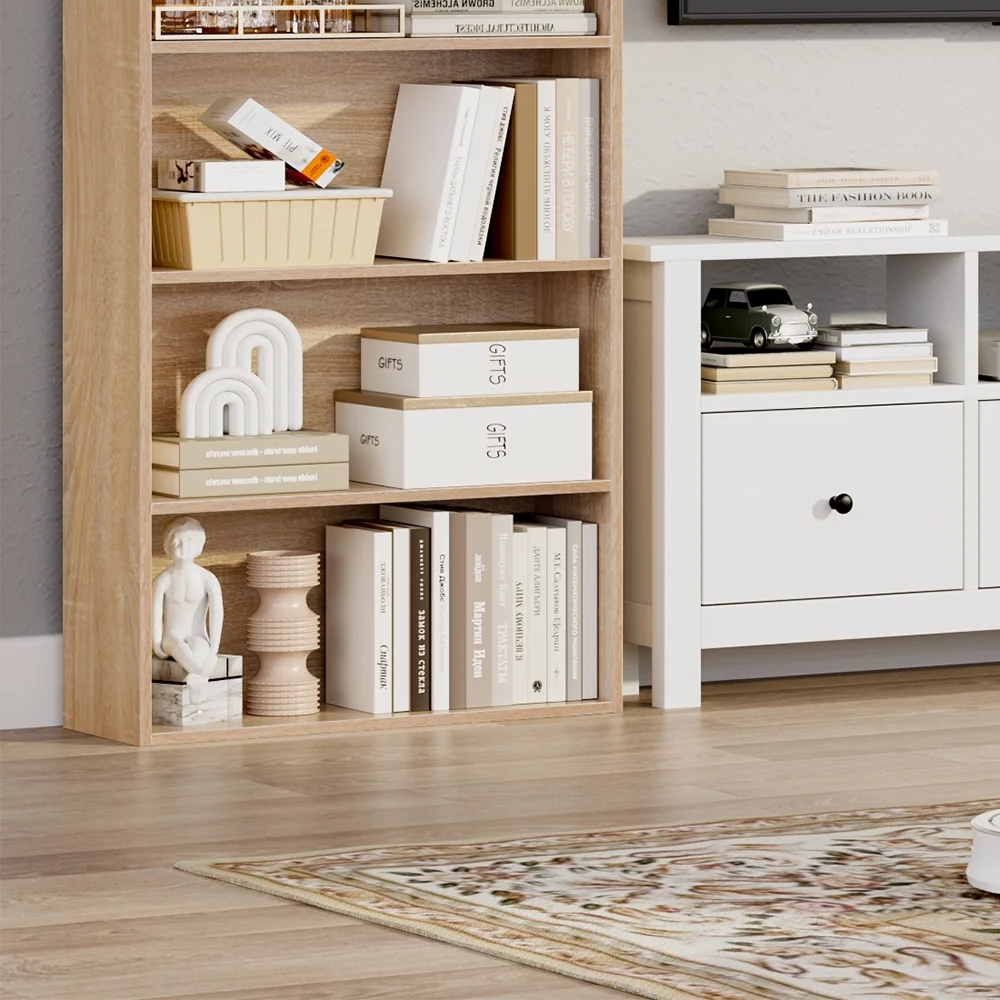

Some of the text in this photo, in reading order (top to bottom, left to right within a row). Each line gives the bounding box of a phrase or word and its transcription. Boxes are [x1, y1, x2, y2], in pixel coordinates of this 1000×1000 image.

[265, 127, 299, 153] PIE MIX
[543, 115, 551, 138] МОГУ
[490, 148, 501, 177] Религия
[543, 142, 551, 195] ОБЪЯСНИТЬ
[562, 131, 574, 233] НЕ БЕРИ В ГОЛОВУ
[797, 194, 827, 203] THE
[832, 192, 893, 202] FASHION
[476, 207, 489, 246] водолазки
[378, 356, 403, 371] GIFTS
[488, 343, 507, 386] GIFTS
[360, 434, 380, 447] GIFTS
[486, 422, 507, 460] GIFTS
[438, 575, 446, 602] Джобс
[532, 546, 541, 616] ДАНТЕ АЛИГЬЕРИ
[472, 601, 485, 678] Мартин Иден
[497, 622, 508, 683] ТРАКТАТЫ
[377, 644, 389, 690] Спартак
